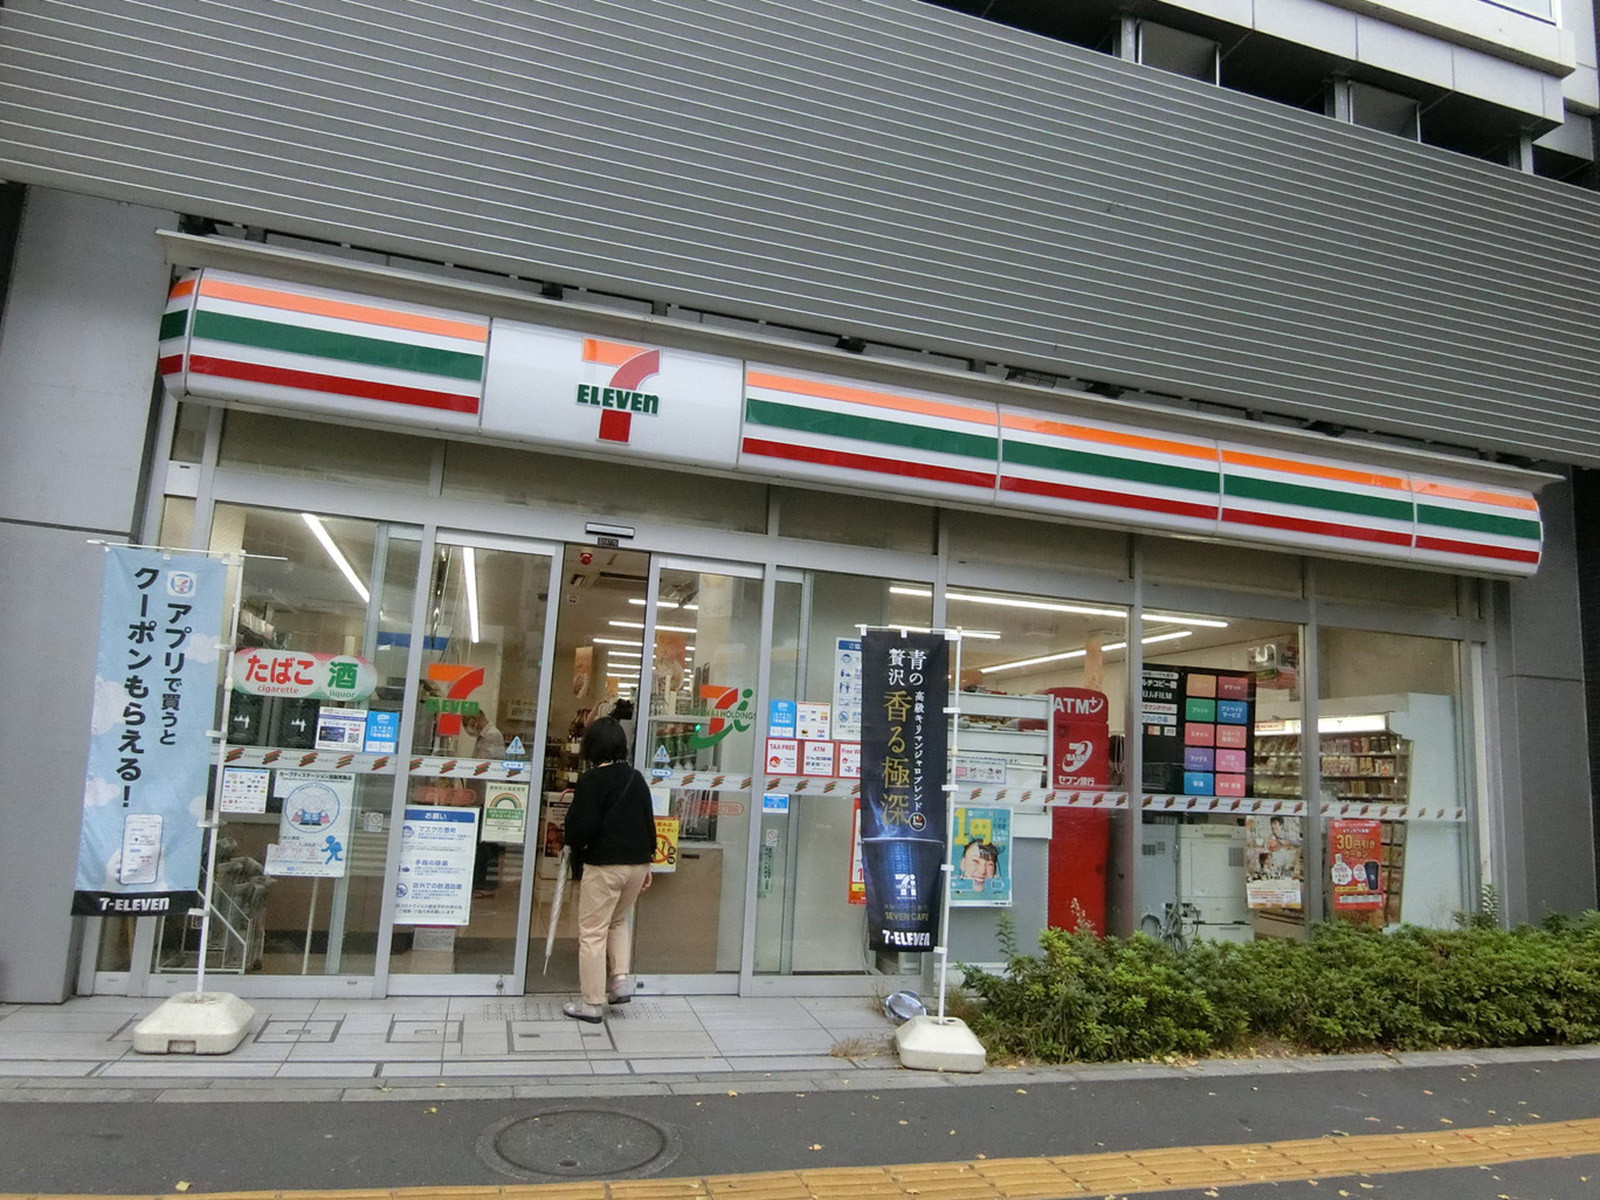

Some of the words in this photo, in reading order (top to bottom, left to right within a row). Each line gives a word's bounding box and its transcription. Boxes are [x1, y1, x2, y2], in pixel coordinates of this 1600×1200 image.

[160, 603, 192, 745] アプリで買うと
[245, 655, 314, 685] たばこ
[328, 662, 358, 689] 酒
[889, 649, 906, 686] 贅沢
[908, 651, 927, 686] 青の
[257, 685, 300, 695] cigarette
[329, 690, 356, 698] liquor
[841, 748, 853, 756] Free
[881, 691, 912, 825] 香る極深
[914, 691, 925, 811] 高級キリマンジャロブレンド
[1058, 775, 1095, 786] セブン銀行
[425, 812, 447, 820] お願い
